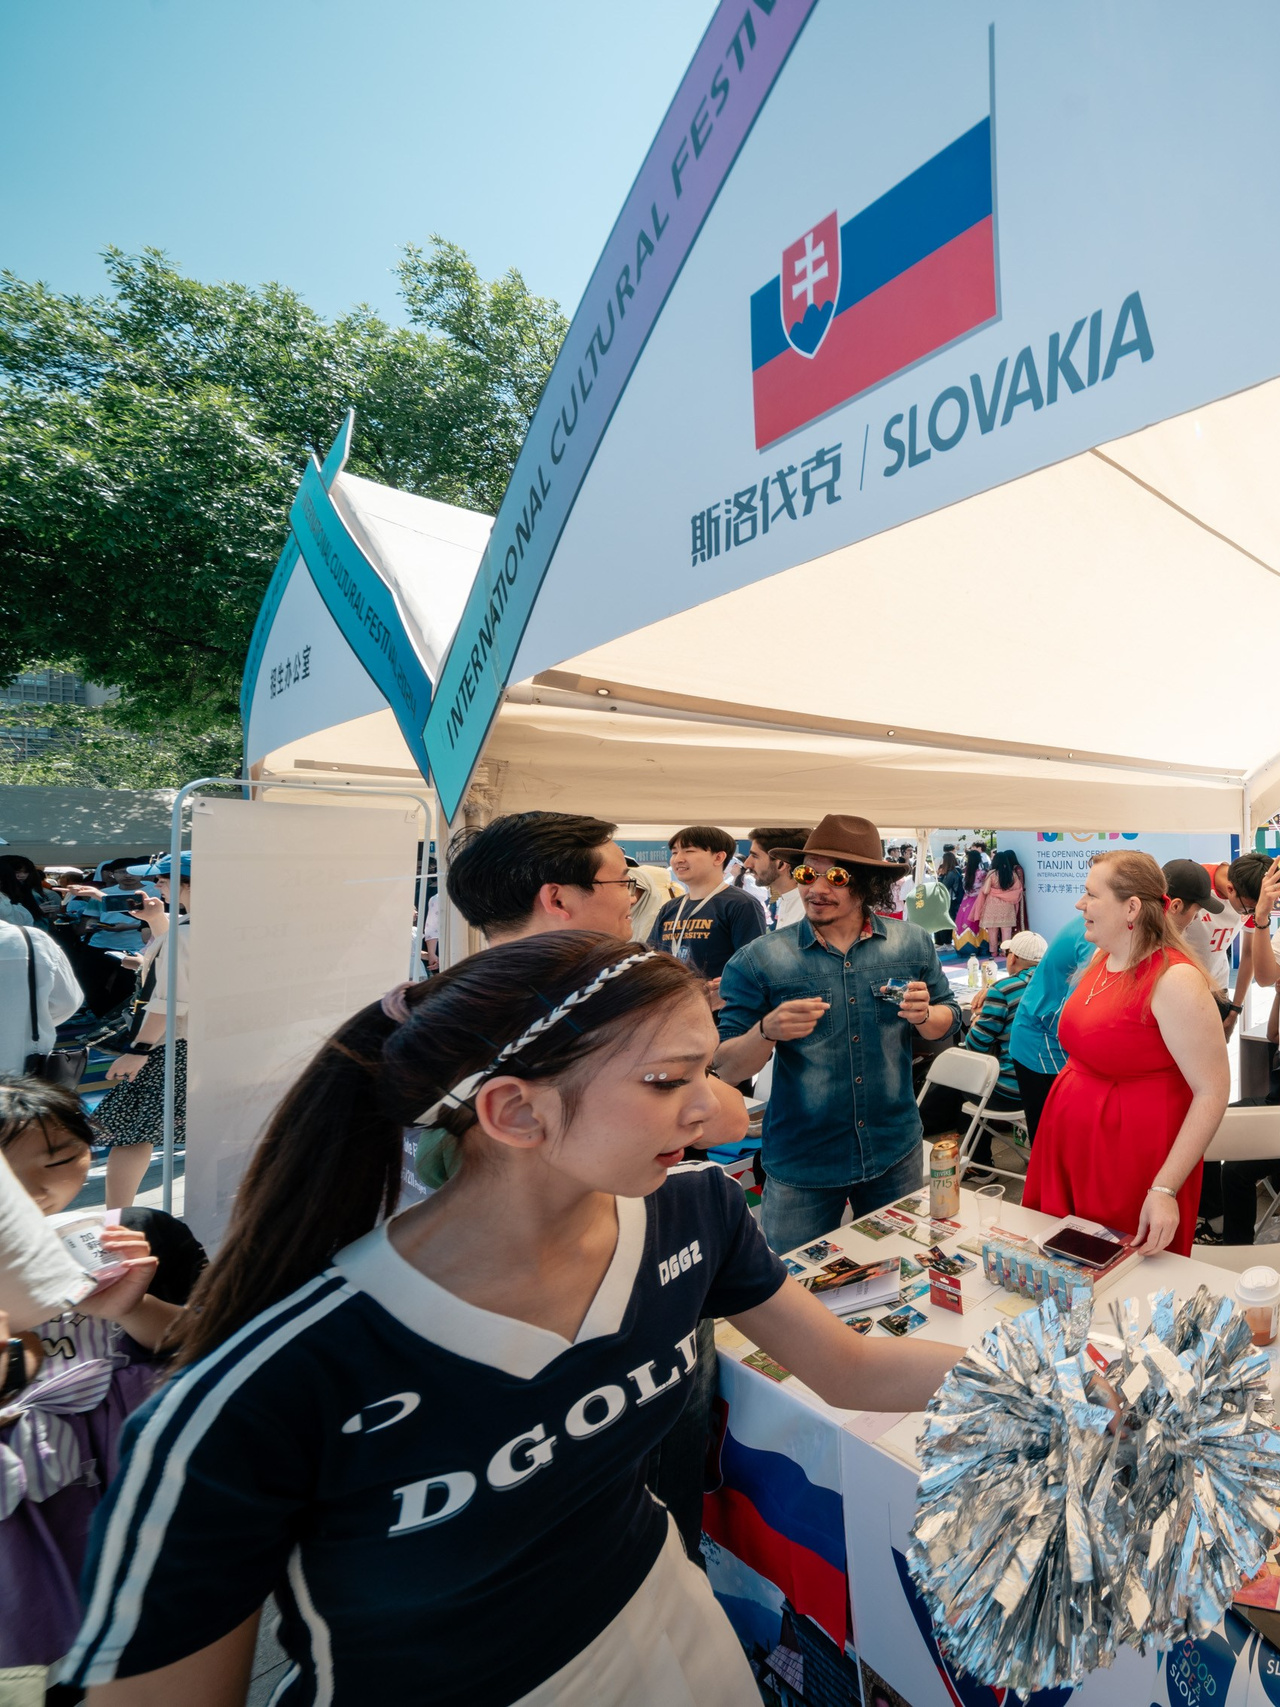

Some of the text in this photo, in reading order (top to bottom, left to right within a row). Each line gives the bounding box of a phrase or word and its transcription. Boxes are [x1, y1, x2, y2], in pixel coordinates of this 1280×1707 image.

[446, 0, 777, 750] INTERNATIONAL CULTURAL FESTI
[883, 290, 1155, 478] SLOVAKIA
[690, 439, 844, 568] 斯洛伐克
[329, 553, 364, 622] CULTURAL
[364, 605, 399, 677] FESTIVAL
[270, 644, 311, 700] 招生办公室
[636, 850, 668, 861] POST OFFICE
[1037, 860, 1073, 870] TIANJIN
[1052, 850, 1084, 858] OPENING
[662, 932, 711, 942] UNIVRSITY
[933, 1178, 953, 1189] 1715
[1169, 1663, 1200, 1707] SLOV
